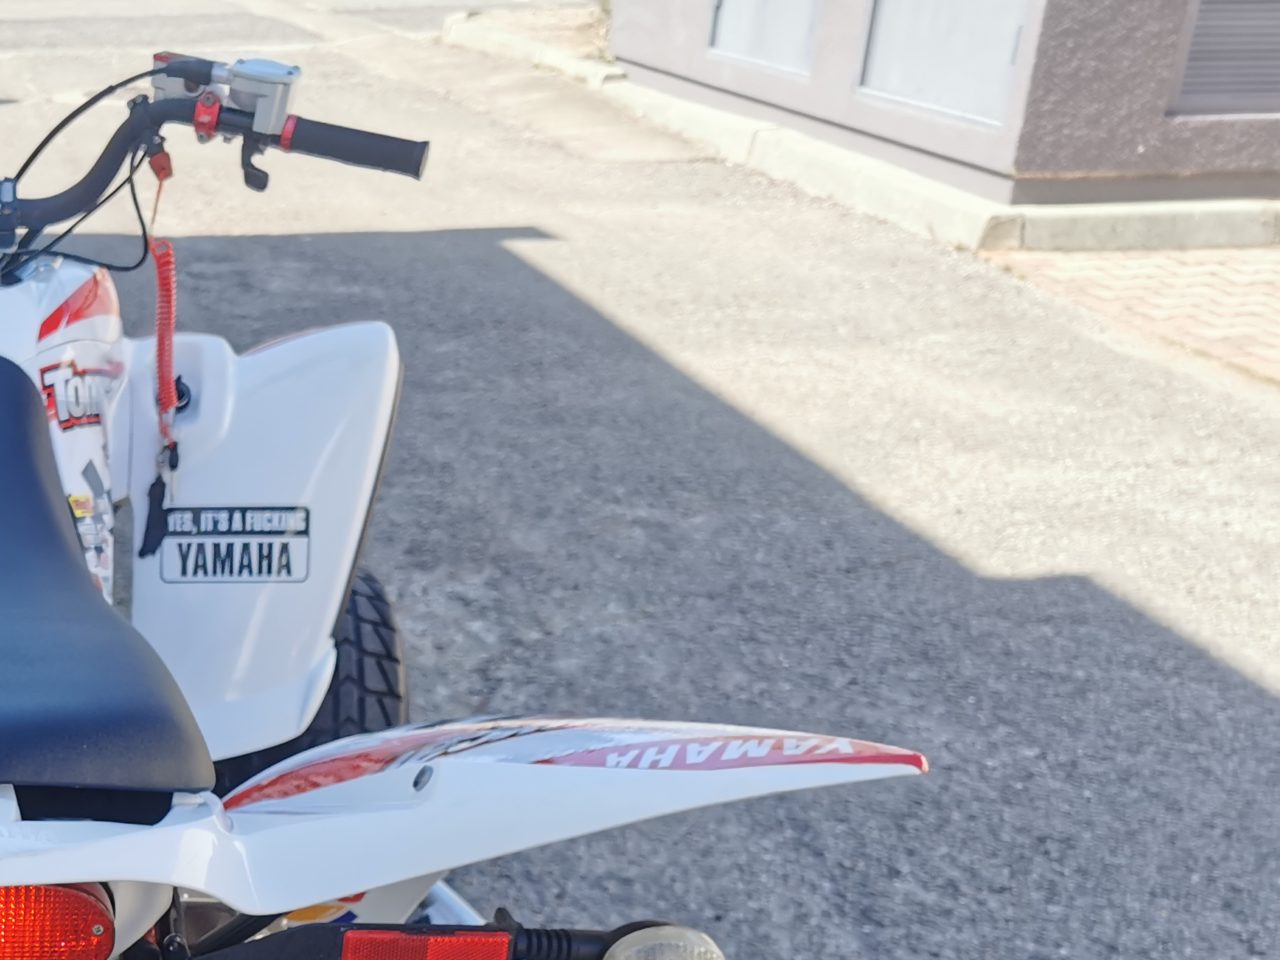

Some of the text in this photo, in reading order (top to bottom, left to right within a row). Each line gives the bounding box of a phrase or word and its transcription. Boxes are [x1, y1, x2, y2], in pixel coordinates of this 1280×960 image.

[167, 510, 198, 534] YES,
[200, 510, 229, 533] IT'S
[231, 510, 244, 533] A
[177, 542, 292, 577] YAMAHA
[605, 737, 854, 769] YAMAHA
